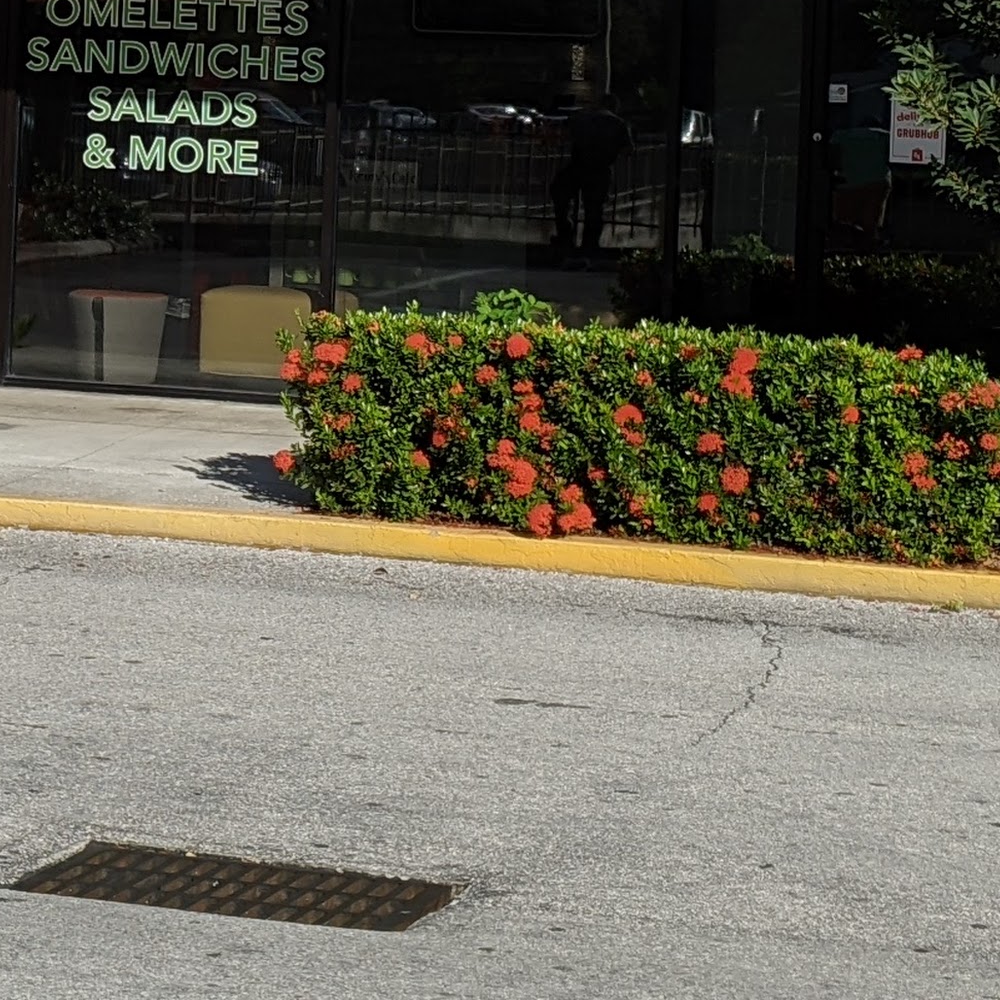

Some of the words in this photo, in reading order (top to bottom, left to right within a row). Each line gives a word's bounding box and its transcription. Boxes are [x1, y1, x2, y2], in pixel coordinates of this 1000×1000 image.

[25, 36, 326, 83] SANDWICHES
[87, 86, 258, 128] SALADS
[83, 132, 116, 170] &
[128, 135, 260, 177] MORE
